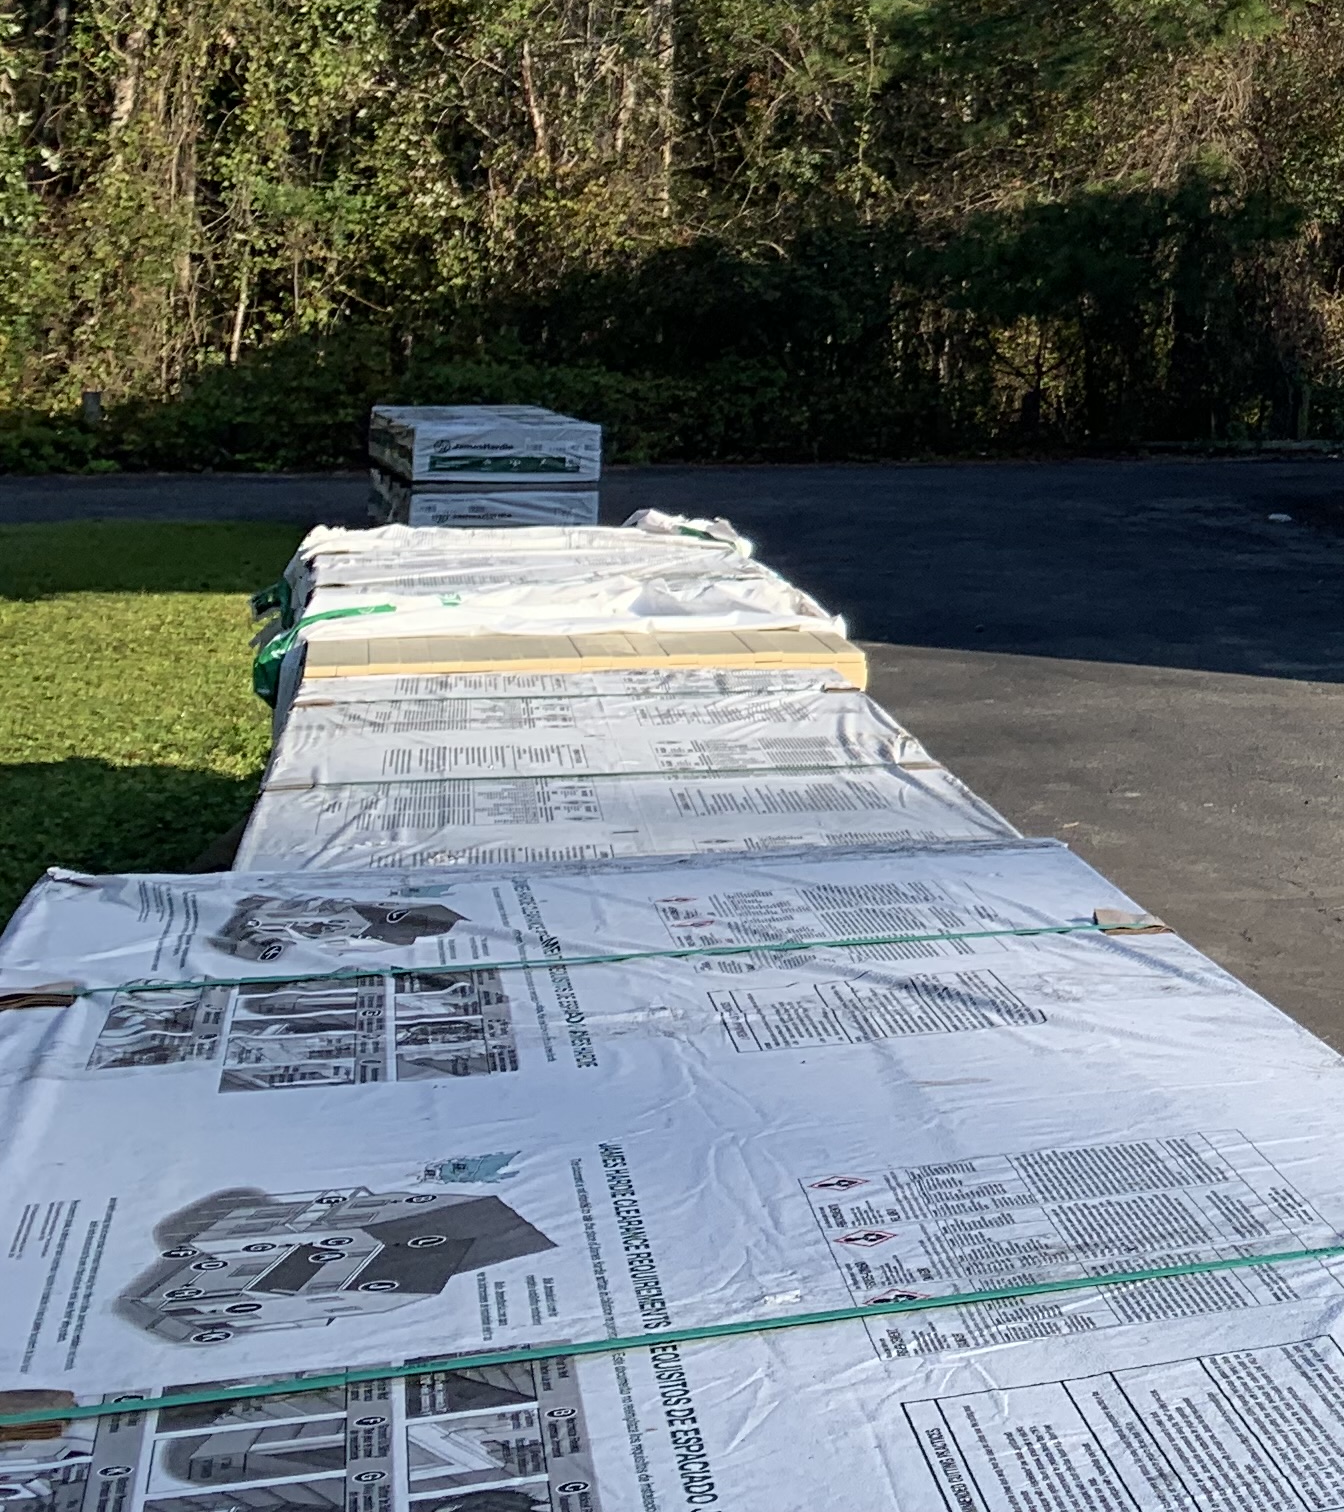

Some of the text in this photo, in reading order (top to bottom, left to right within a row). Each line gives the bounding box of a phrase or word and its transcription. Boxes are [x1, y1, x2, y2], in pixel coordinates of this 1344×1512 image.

[598, 1143, 629, 1168] JAMES
[613, 1198, 650, 1252] CLEARANCE
[624, 1252, 673, 1330] REQUIREMENTS
[665, 1406, 696, 1429] DE
[669, 1428, 719, 1505] ESPACIADO
